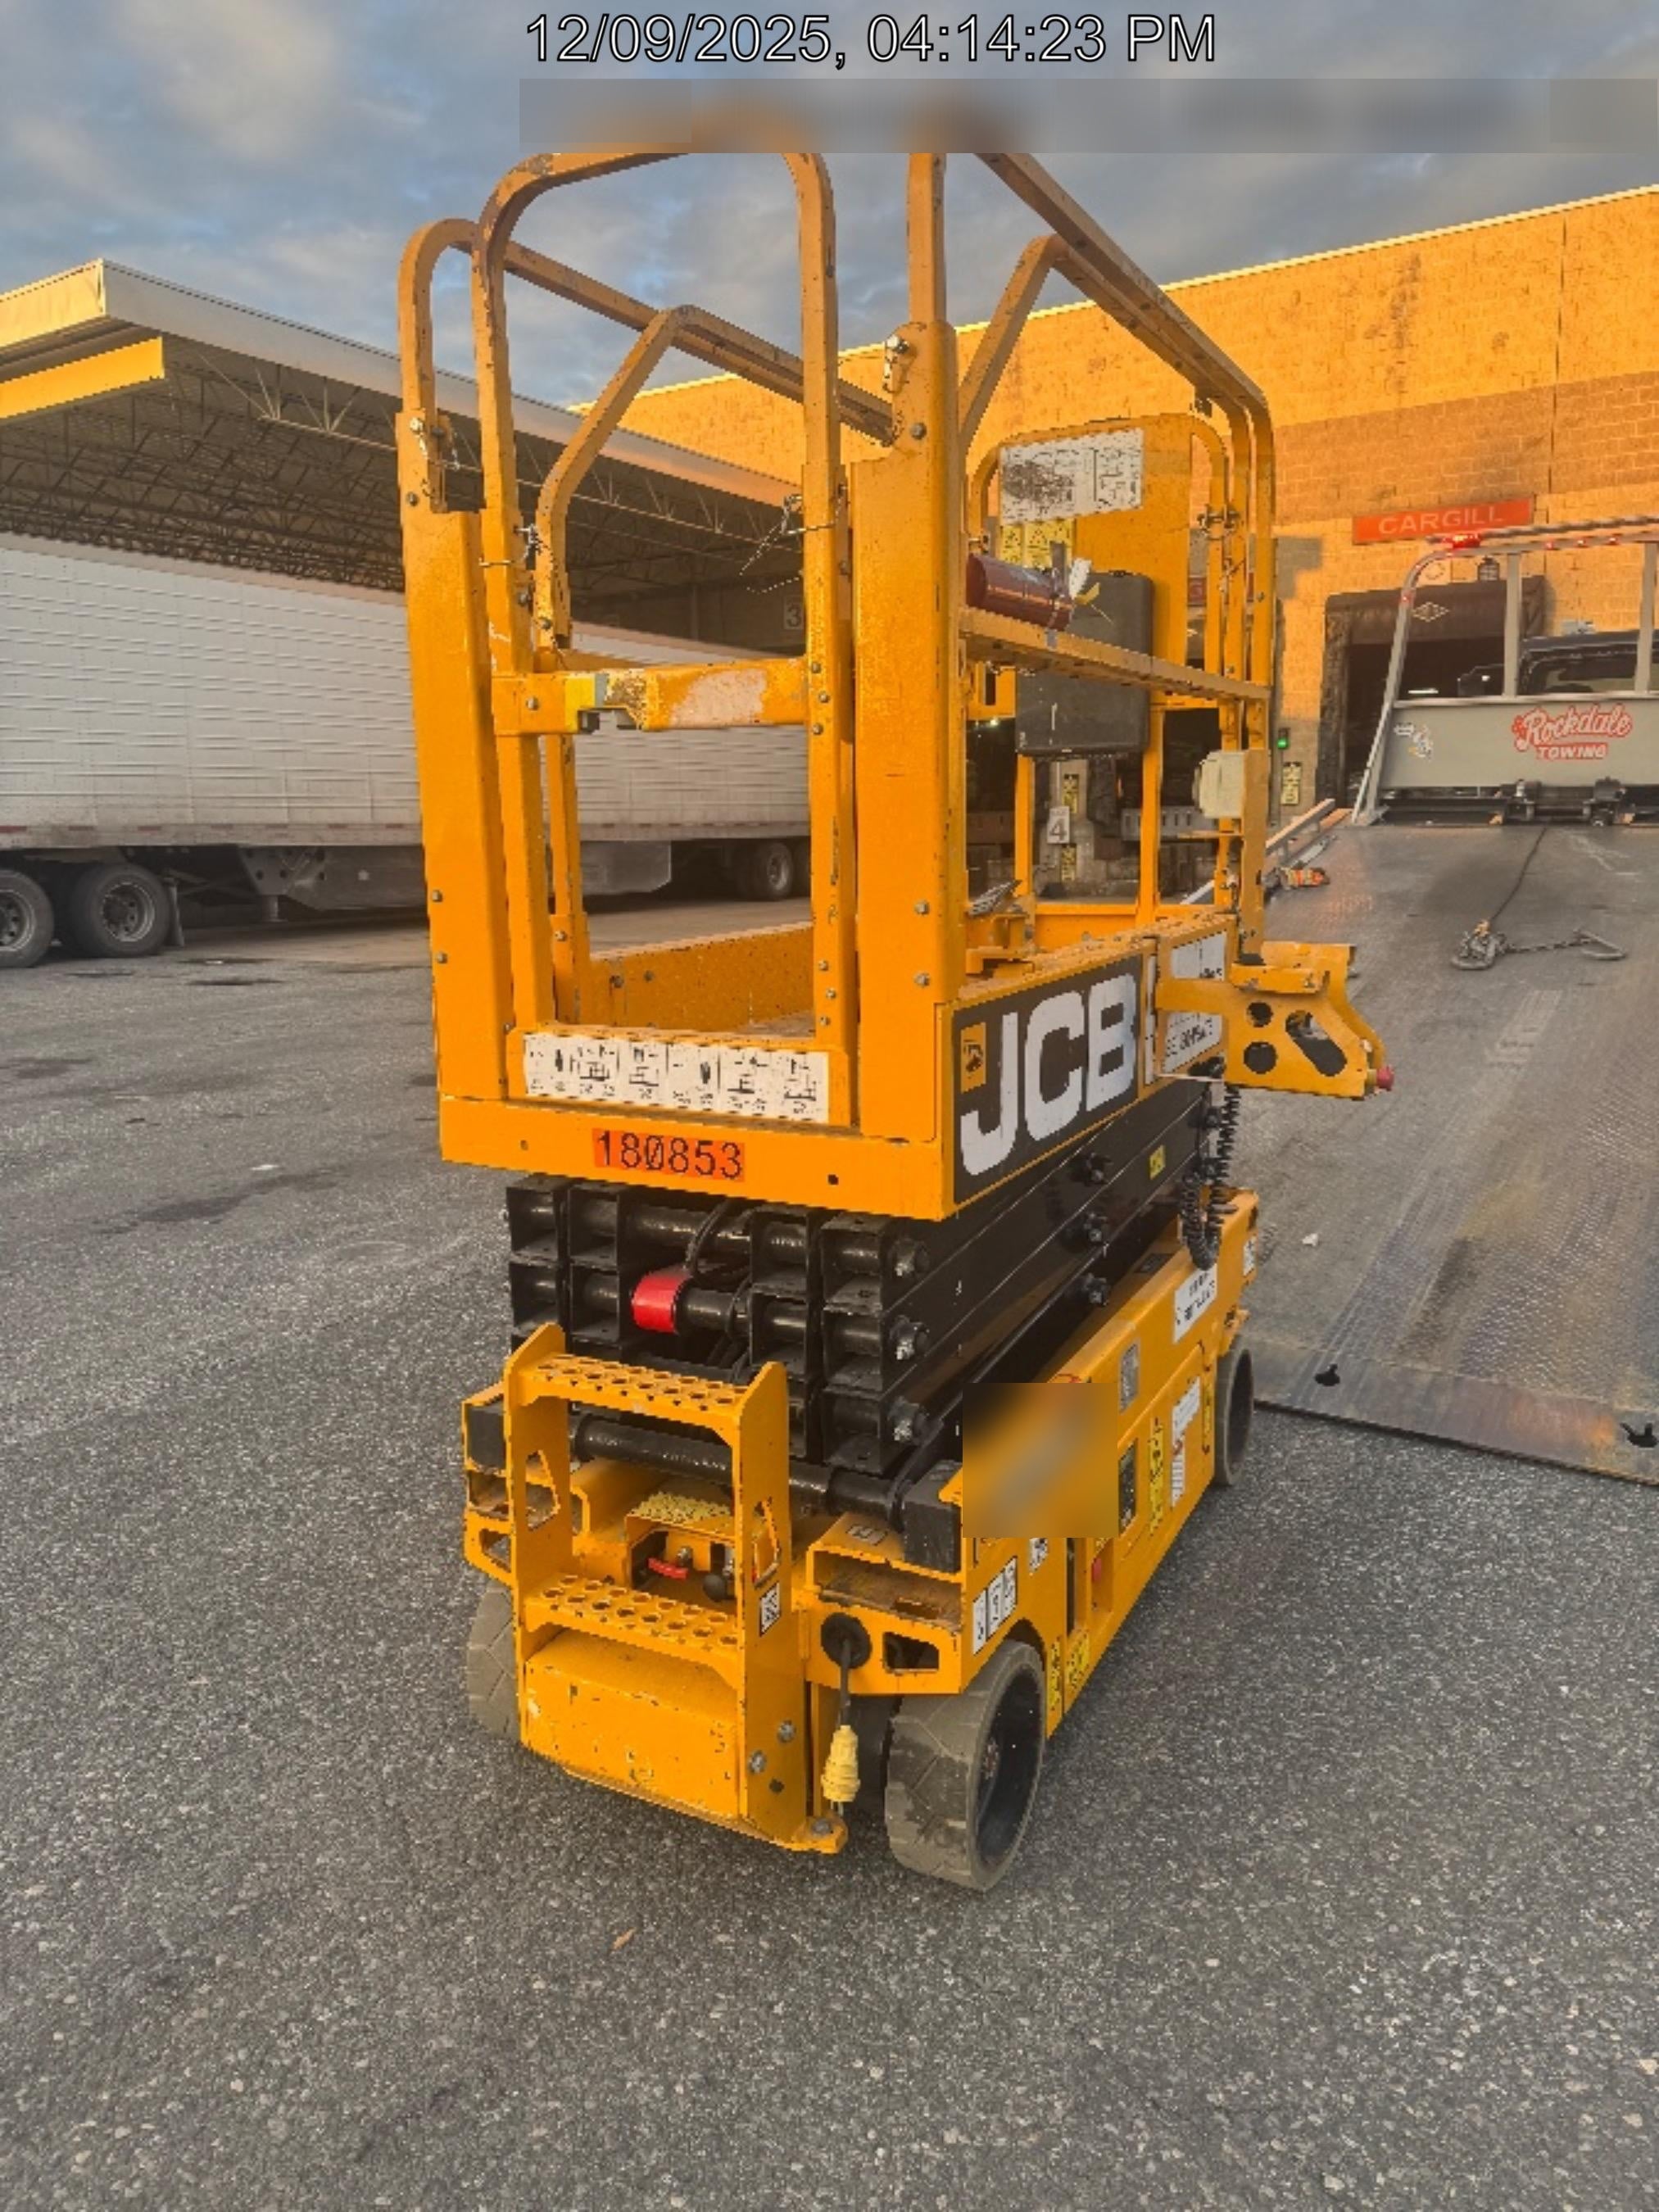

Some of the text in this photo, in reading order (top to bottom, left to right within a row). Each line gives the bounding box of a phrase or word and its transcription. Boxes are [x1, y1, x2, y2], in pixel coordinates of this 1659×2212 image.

[1378, 506, 1503, 534] CARGILL
[1513, 703, 1632, 751] Rockdale
[1535, 744, 1607, 760] TOWING
[1049, 817, 1067, 841] 4
[960, 972, 1137, 1176] JCB
[599, 1130, 742, 1181] 180853
